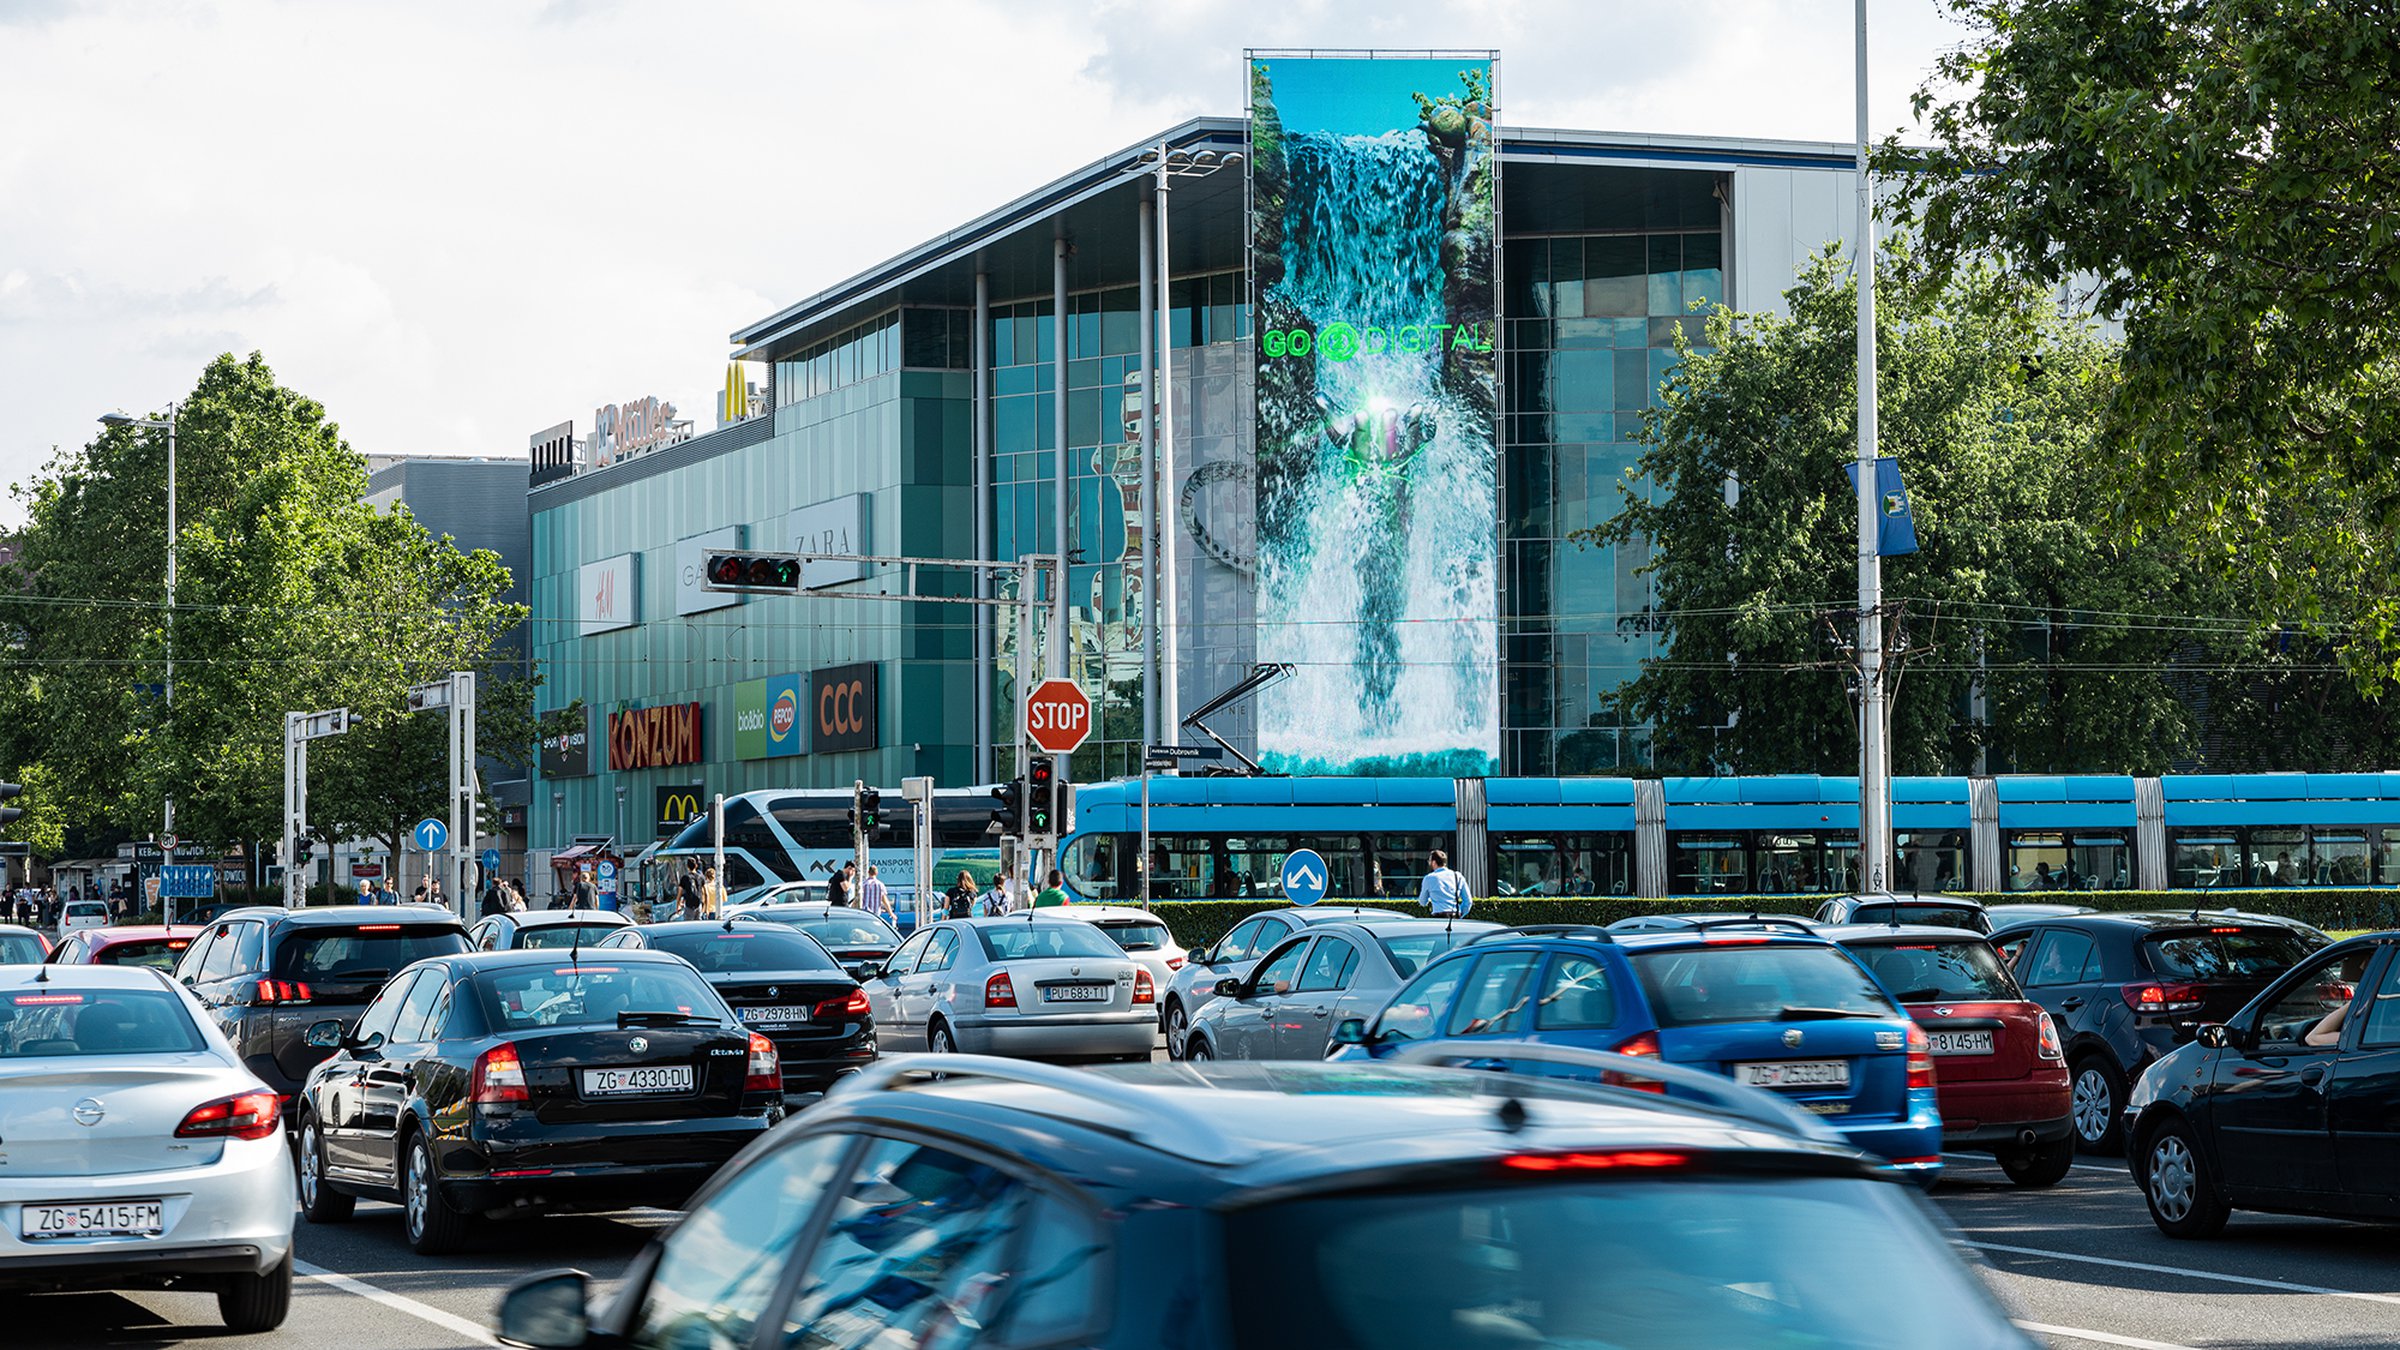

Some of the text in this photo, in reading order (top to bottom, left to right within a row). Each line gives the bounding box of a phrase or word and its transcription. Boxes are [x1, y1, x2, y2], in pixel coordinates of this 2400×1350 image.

[1263, 329, 1311, 358] GO
[1367, 323, 1493, 355] DIGITAL
[795, 527, 850, 555] ZARA
[595, 568, 614, 620] H&M
[738, 708, 764, 732] bio&bio
[774, 706, 792, 724] PEPCO
[820, 680, 863, 736] CCC
[1031, 701, 1086, 730] STOP
[609, 702, 697, 770] KONZUM
[1170, 748, 1200, 756] Dubrovnik
[1051, 987, 1064, 999] PU
[744, 1008, 758, 1021] ZG
[597, 1071, 617, 1089] ZG
[39, 1208, 64, 1231] ZG
